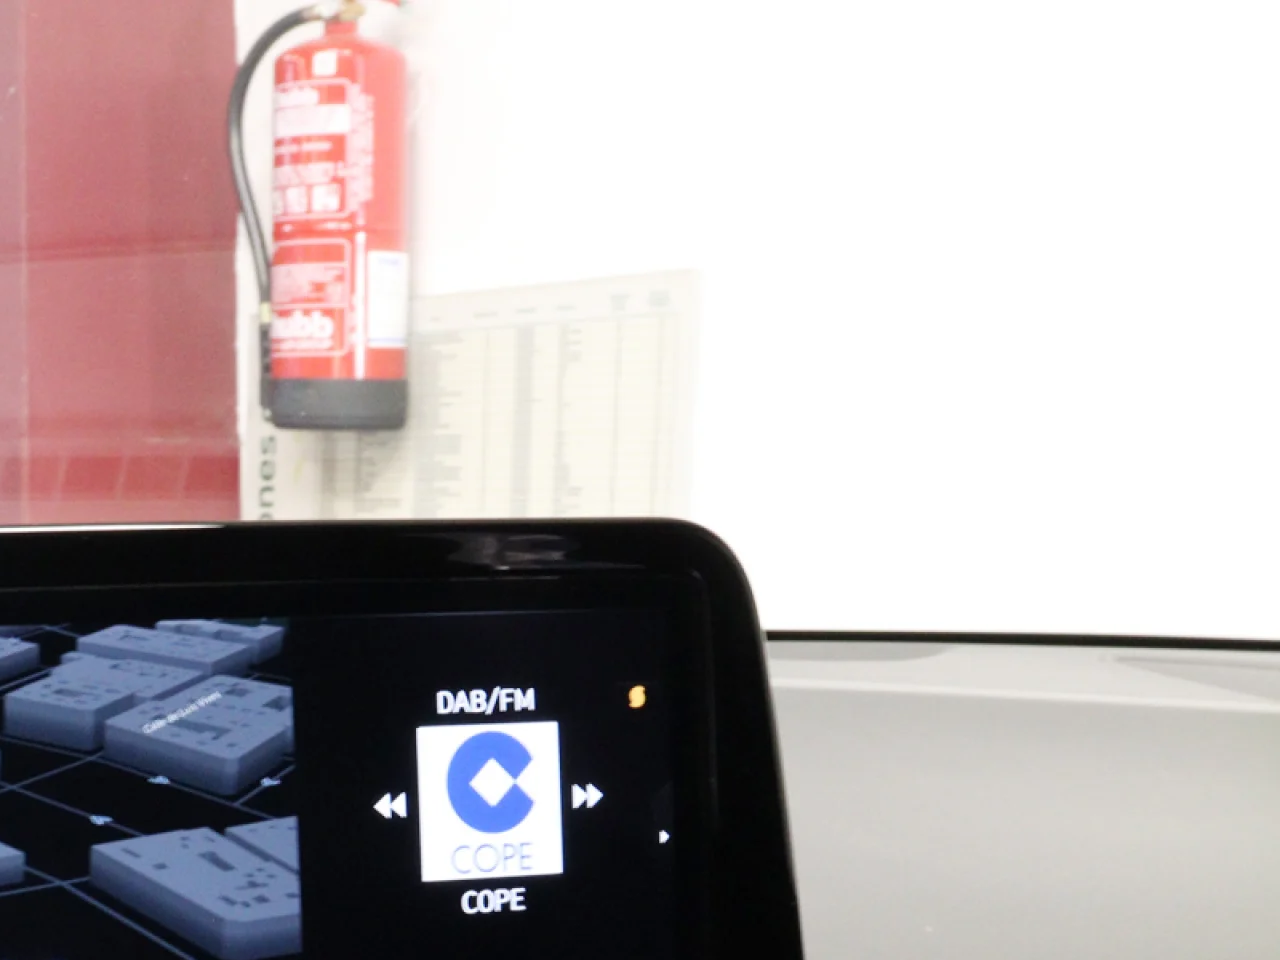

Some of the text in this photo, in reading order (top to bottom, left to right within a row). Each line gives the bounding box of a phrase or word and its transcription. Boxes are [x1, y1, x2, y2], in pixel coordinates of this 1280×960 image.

[436, 687, 536, 715] DAB/FM
[451, 842, 534, 874] COPE
[461, 888, 526, 914] COPE
